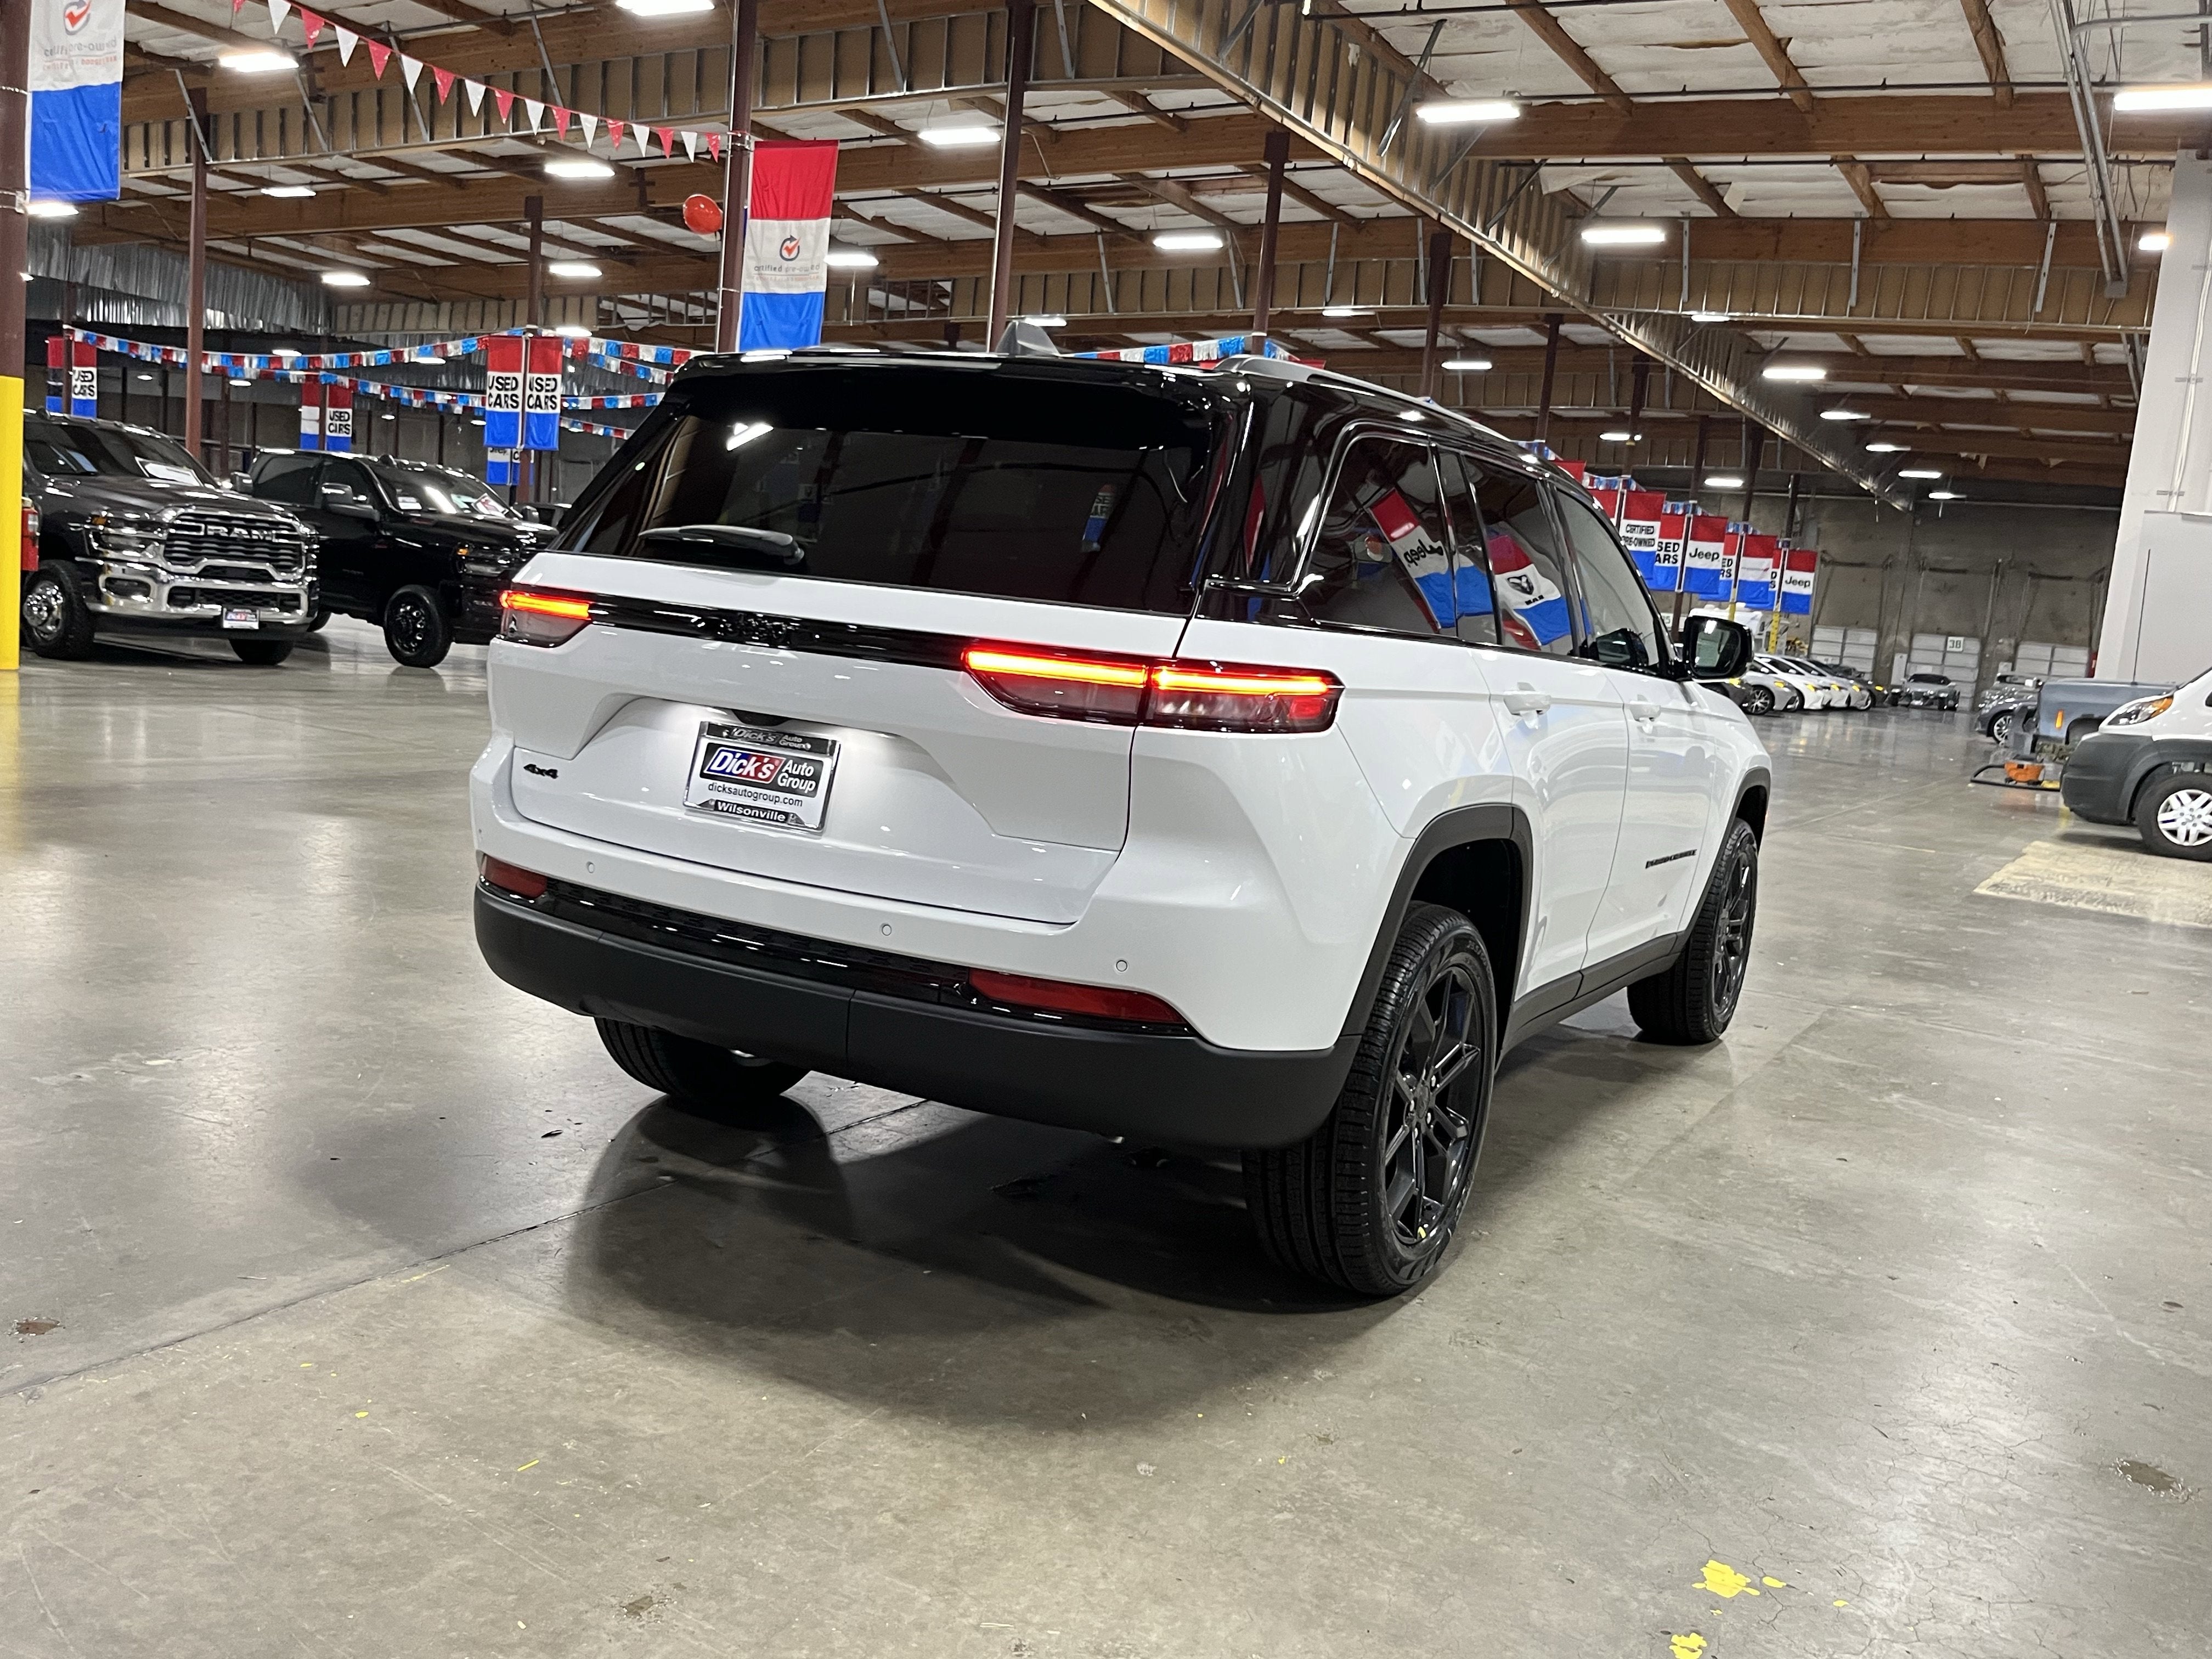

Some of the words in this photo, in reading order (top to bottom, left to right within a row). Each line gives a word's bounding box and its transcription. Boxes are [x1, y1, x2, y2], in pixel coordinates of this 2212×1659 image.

[785, 263, 820, 273] pre-owed
[489, 376, 519, 391] USED
[529, 377, 557, 393] USED
[488, 393, 520, 409] CARS
[527, 394, 557, 410] CARS
[329, 410, 350, 421] USED
[207, 526, 275, 542] RAM
[1657, 541, 1680, 552] SED
[1655, 554, 1678, 565] ARS
[1689, 548, 1719, 562] Jeep
[1785, 577, 1810, 588] Jeep
[733, 729, 776, 742] Dick's
[782, 735, 803, 743] Auto
[710, 751, 775, 780] Dick's
[782, 759, 814, 777] Auto
[777, 772, 816, 794] Group
[708, 782, 803, 808] dicksautogroup.com
[717, 801, 786, 822] Wilsonville
